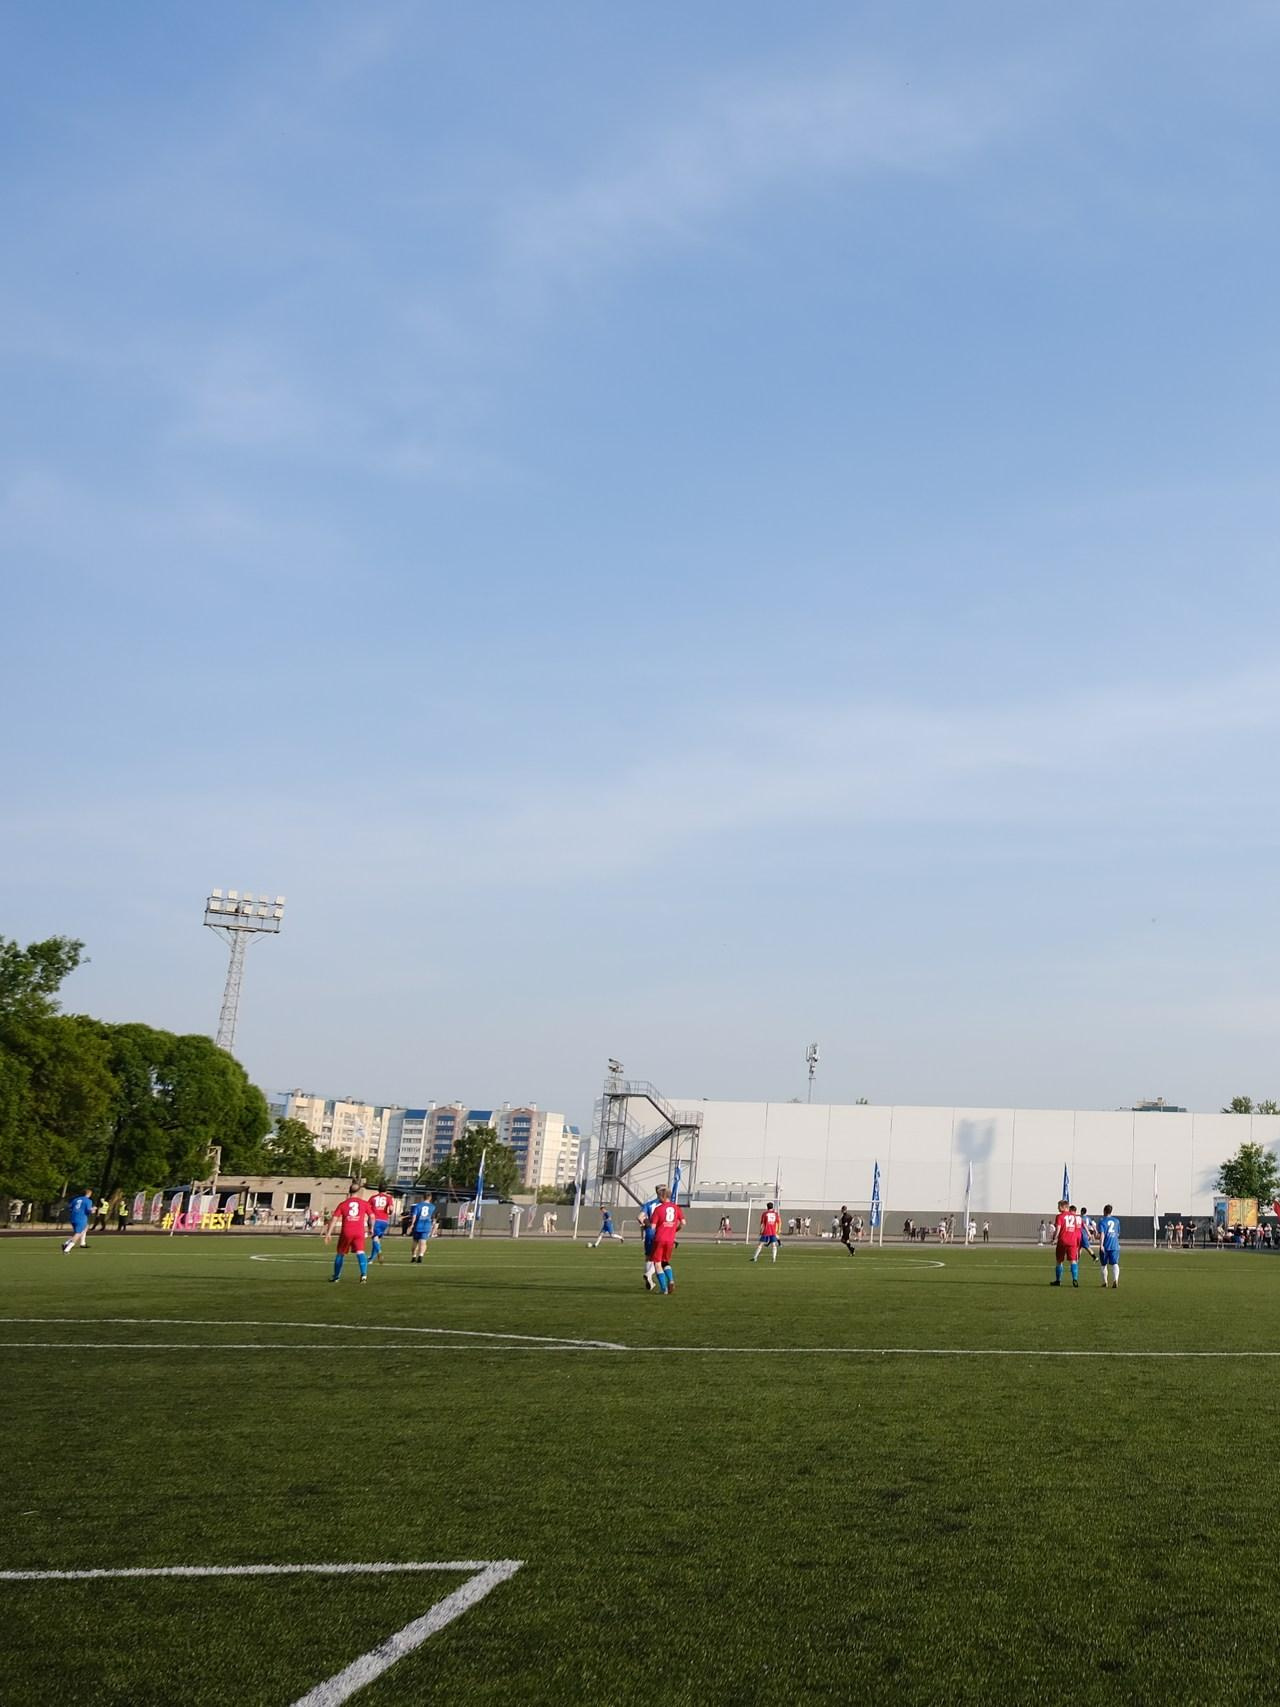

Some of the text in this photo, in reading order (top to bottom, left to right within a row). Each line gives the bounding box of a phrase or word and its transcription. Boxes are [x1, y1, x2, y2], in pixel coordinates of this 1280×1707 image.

[348, 1201, 359, 1217] 3
[421, 1206, 429, 1217] 8
[665, 1206, 675, 1222] 8
[1064, 1215, 1075, 1227] 12
[1107, 1220, 1115, 1232] 2
